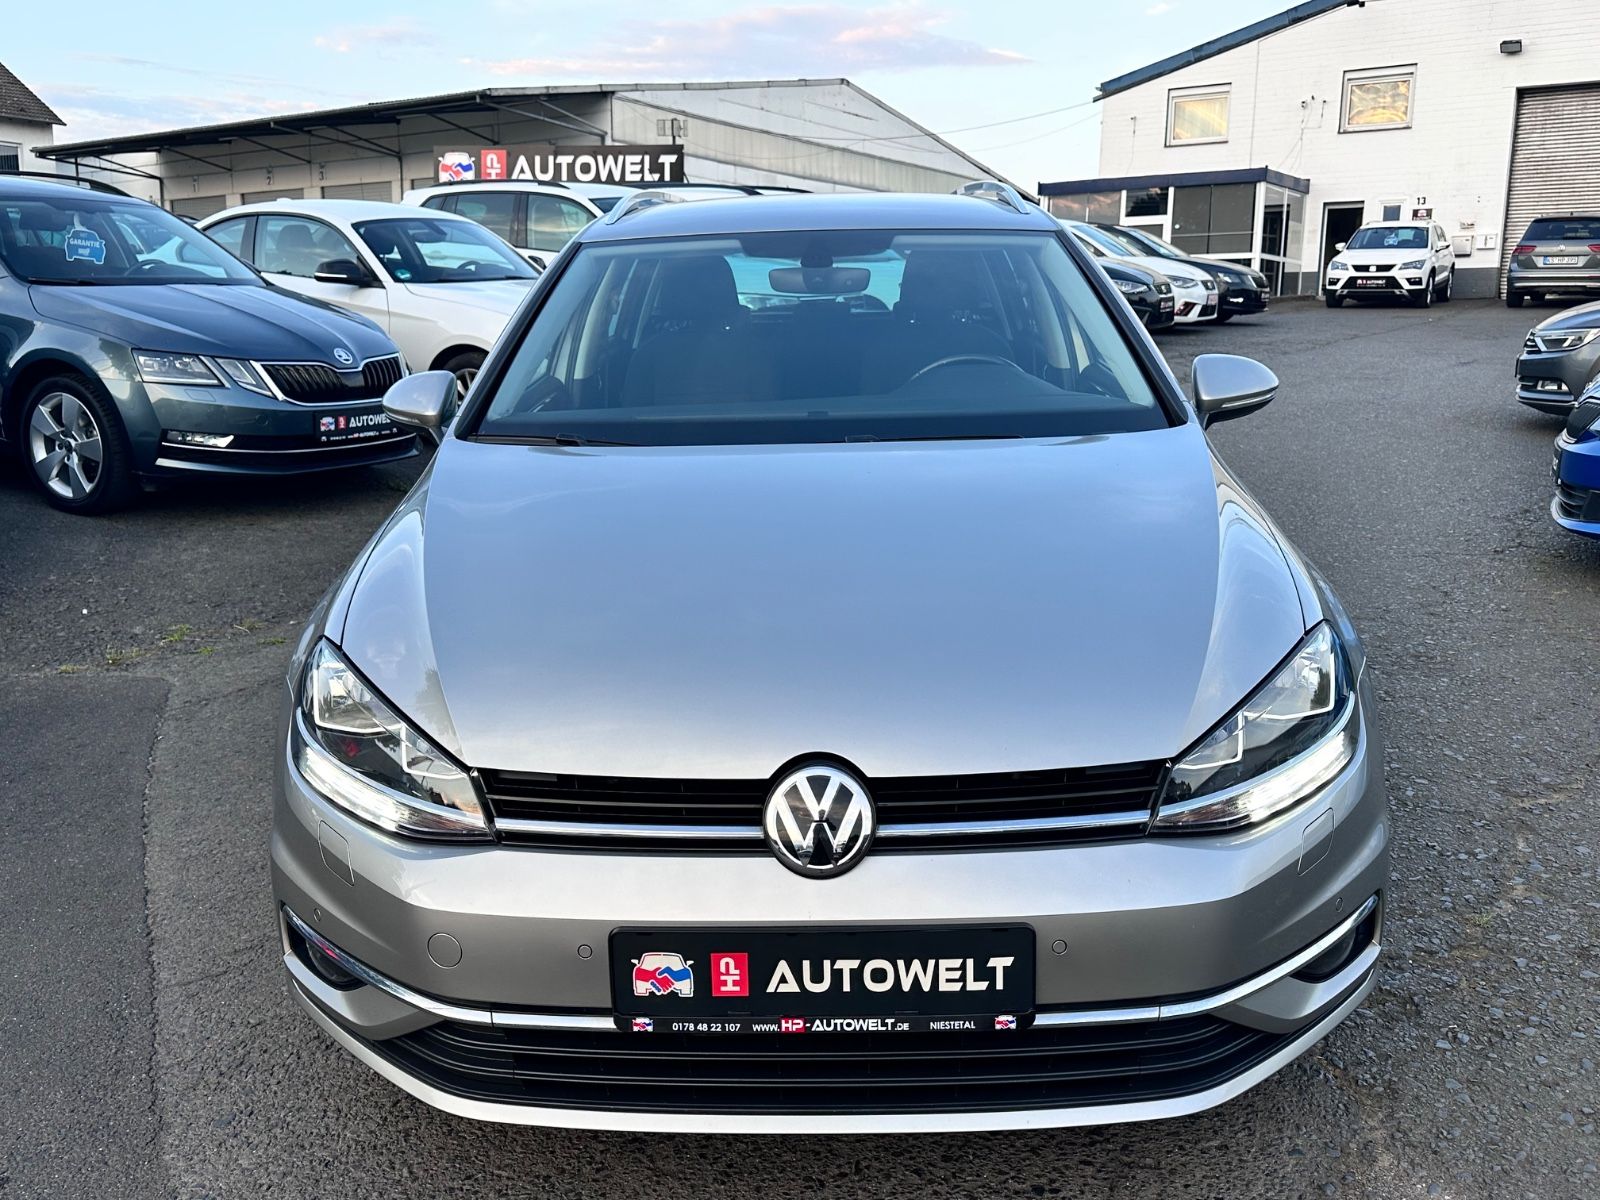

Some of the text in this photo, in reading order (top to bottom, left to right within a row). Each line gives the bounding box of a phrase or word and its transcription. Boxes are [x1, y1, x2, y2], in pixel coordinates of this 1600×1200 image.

[511, 154, 679, 183] AUTOWELT
[1416, 196, 1427, 206] 13
[69, 238, 100, 248] GARANTIE
[720, 956, 1015, 993] HP AUTOWELT
[672, 1022, 695, 1032] 0178
[696, 1023, 709, 1032] 48
[710, 1023, 722, 1032] 22
[724, 1023, 741, 1032] 107
[929, 1020, 976, 1030] NIESTETAL
